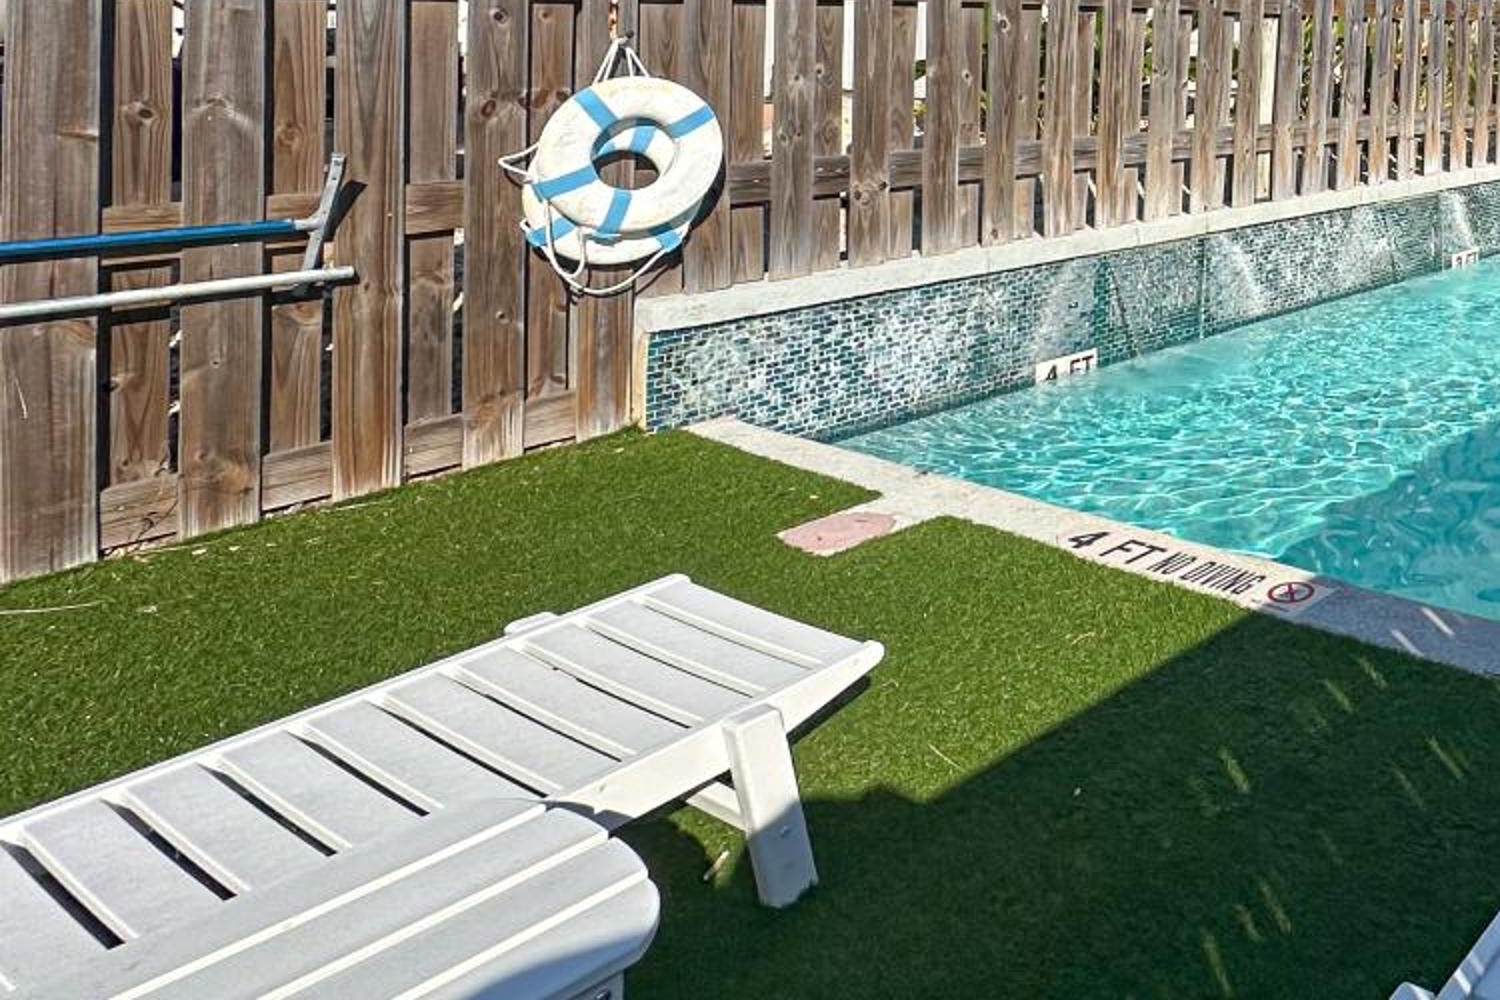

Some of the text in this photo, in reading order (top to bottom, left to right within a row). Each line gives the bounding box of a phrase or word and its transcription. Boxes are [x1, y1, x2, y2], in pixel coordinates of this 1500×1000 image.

[1070, 354, 1094, 375] FT
[1068, 532, 1266, 594] 4 FT NO DIVING
